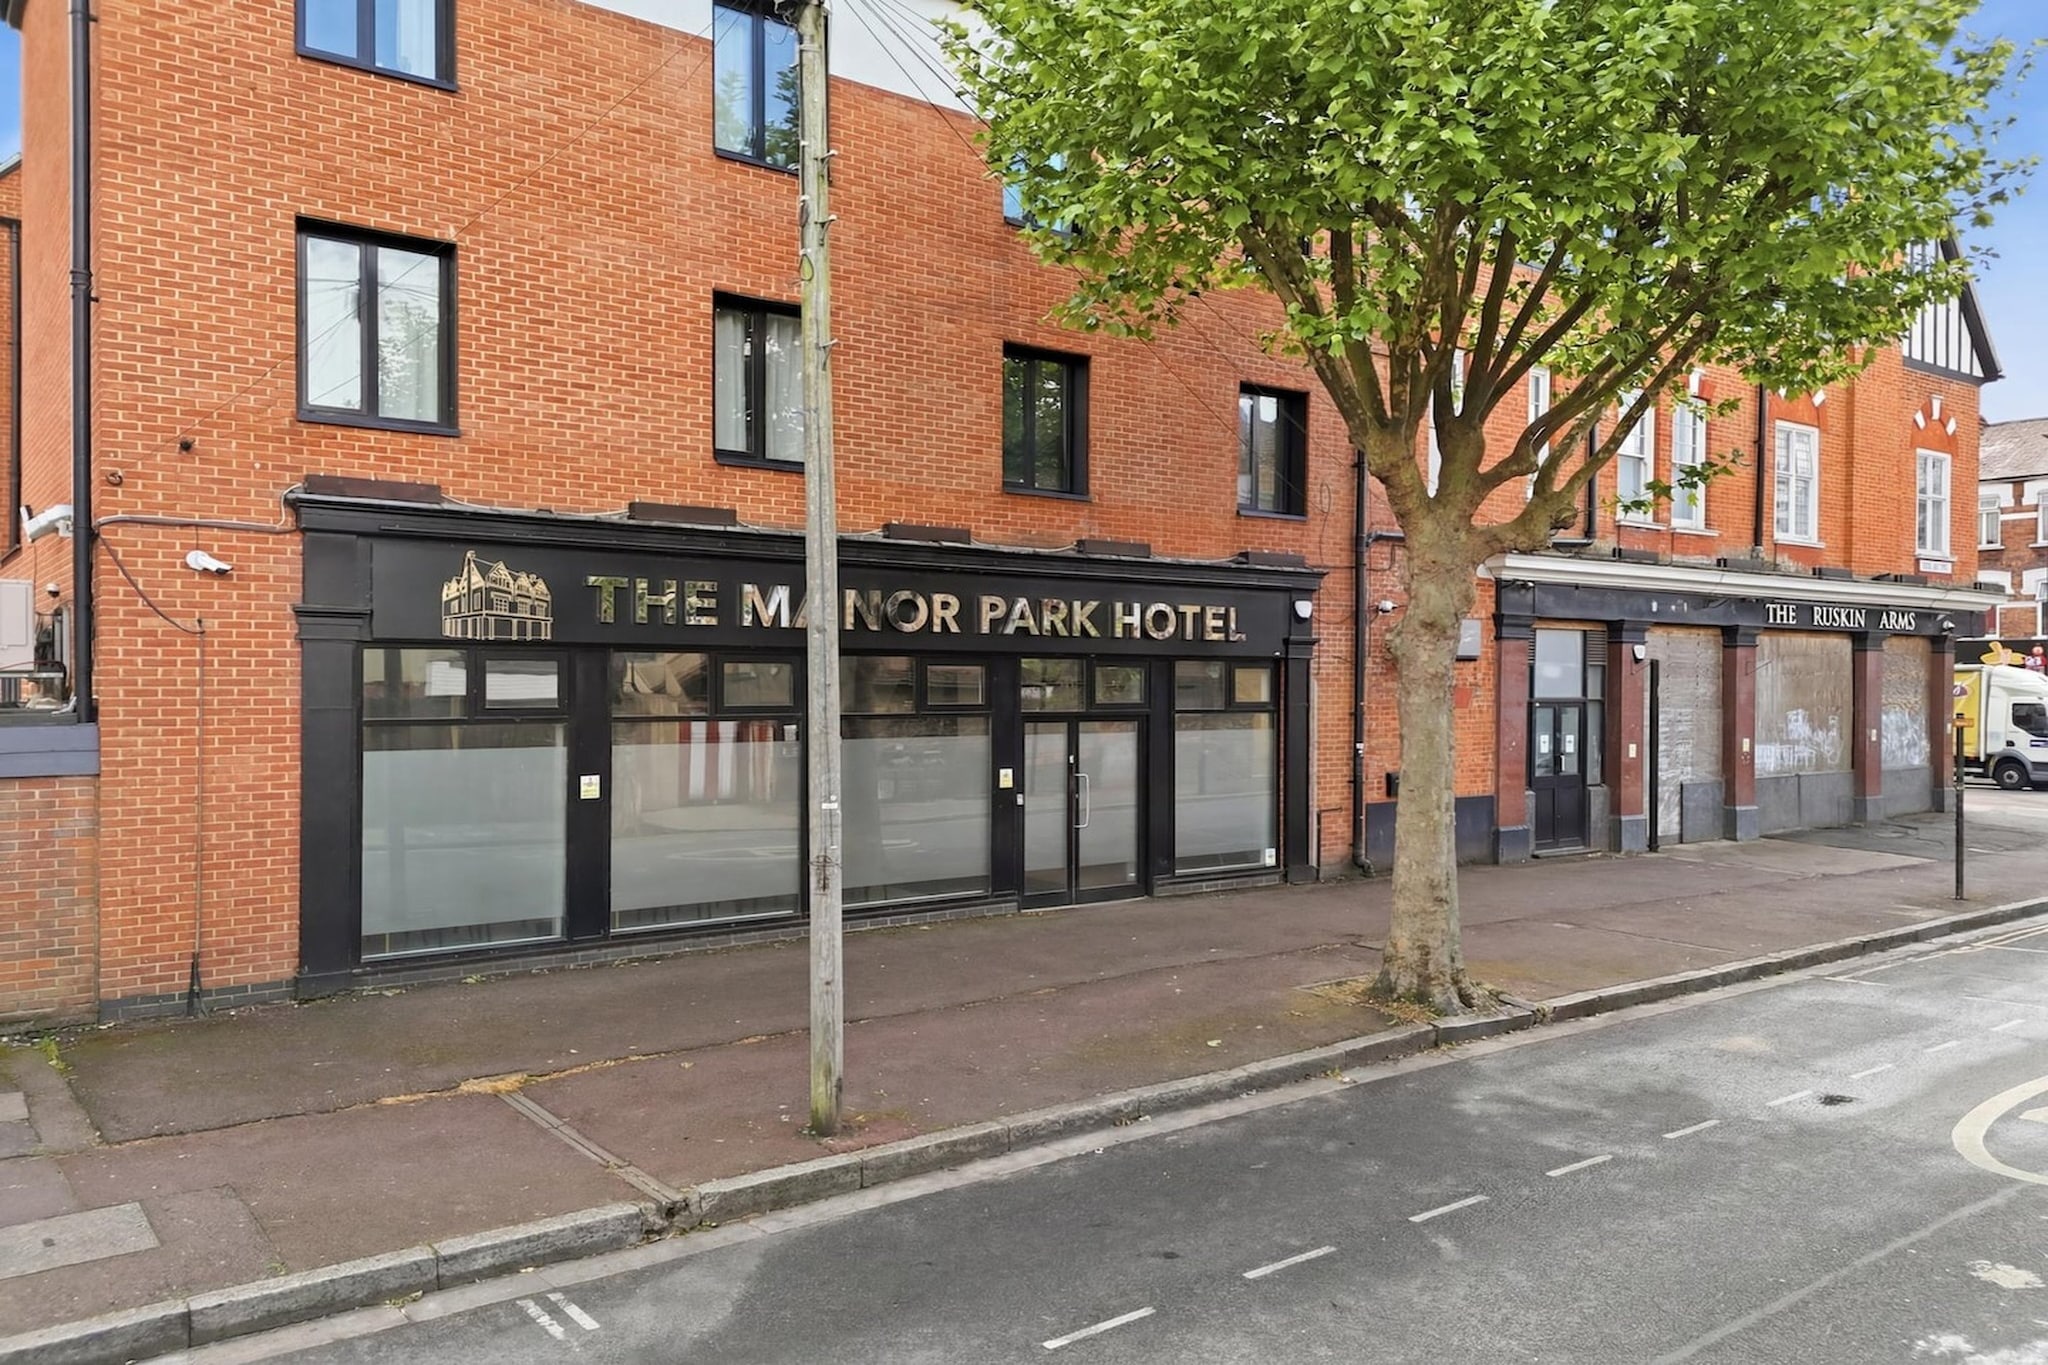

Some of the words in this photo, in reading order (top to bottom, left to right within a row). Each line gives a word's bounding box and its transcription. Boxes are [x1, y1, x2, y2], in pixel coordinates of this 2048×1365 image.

[585, 575, 719, 626] THE
[975, 594, 1101, 638] PARK
[1110, 601, 1247, 642] HOTEL
[1765, 603, 1797, 625] THE
[1812, 606, 1867, 628] RUSKIN
[1879, 611, 1916, 631] ARMS
